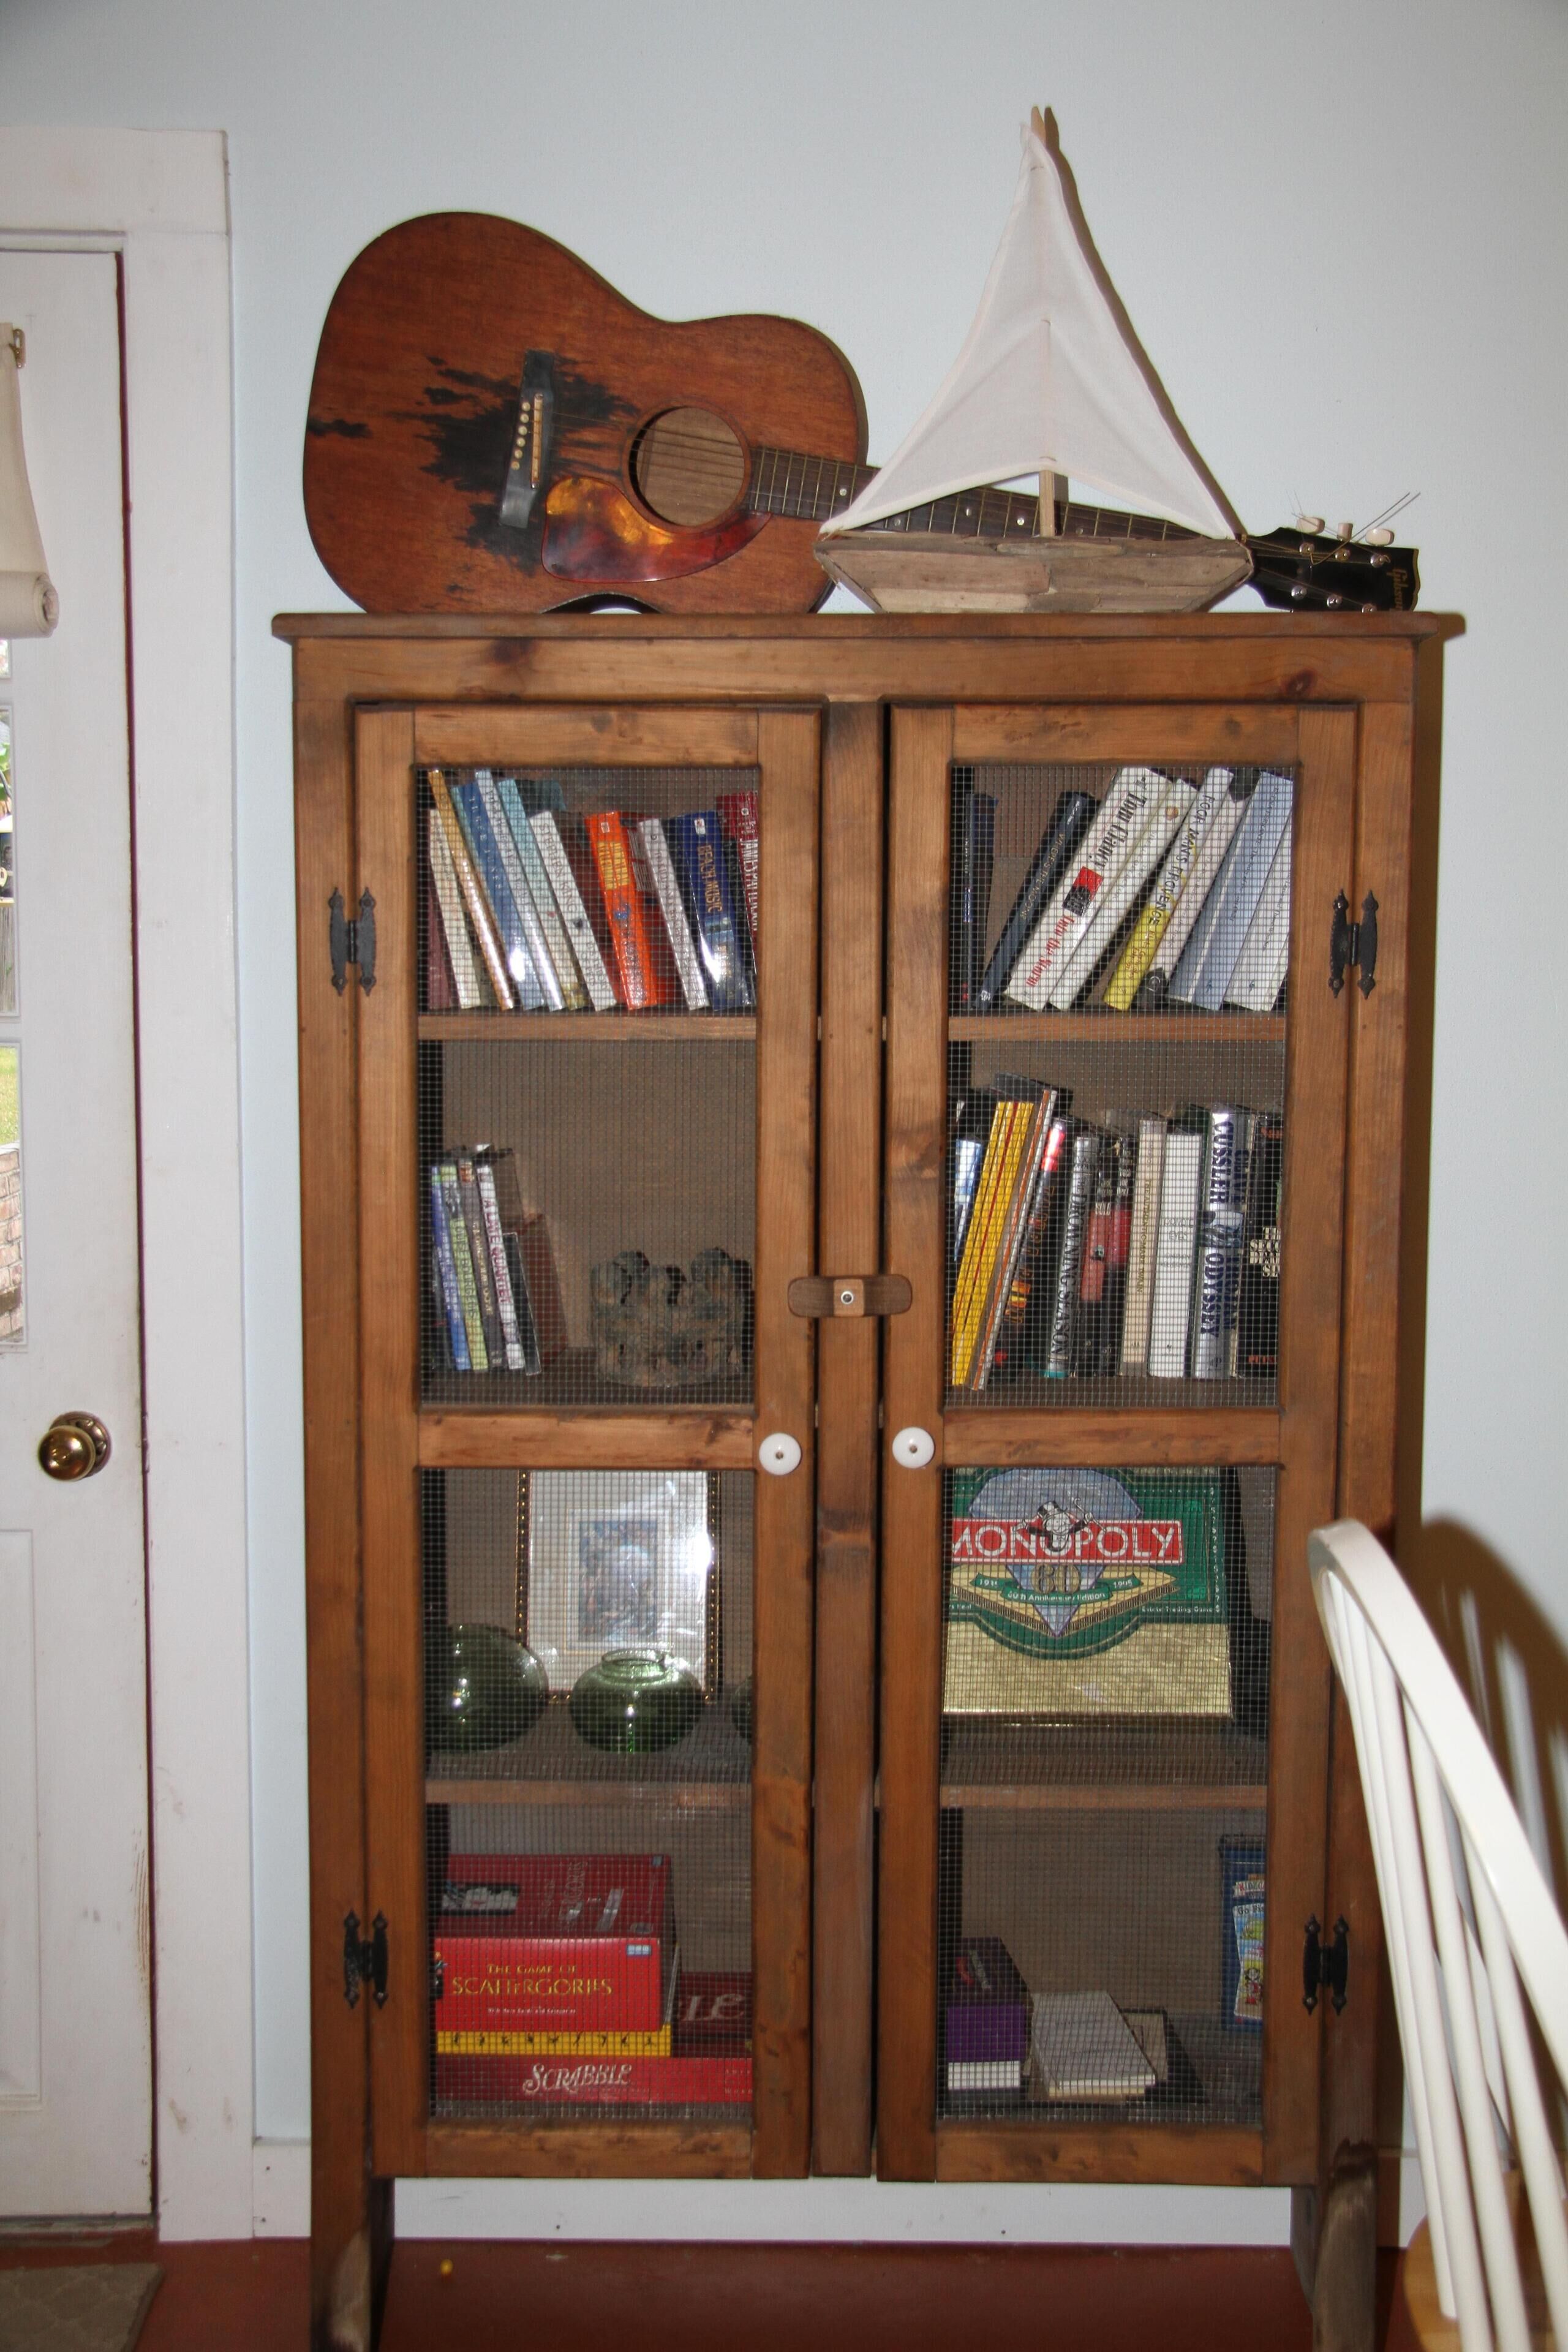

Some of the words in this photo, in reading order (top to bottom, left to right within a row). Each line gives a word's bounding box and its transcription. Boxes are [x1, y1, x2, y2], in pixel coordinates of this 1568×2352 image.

[1114, 789, 1148, 826] Tom
[1191, 793, 1215, 826] POOR
[740, 838, 758, 872] JAMES
[1090, 820, 1129, 869] Clancy
[697, 845, 715, 879] BEACH
[704, 880, 723, 913] MUSIC
[1145, 865, 1183, 927] PROVENCE
[1052, 913, 1076, 939] Into
[1042, 936, 1062, 957] the
[1024, 955, 1052, 989] Storm
[1210, 1121, 1234, 1203] CUSSLER
[484, 1211, 500, 1243] LATE
[1059, 1193, 1088, 1287] DROWNING
[1169, 1231, 1188, 1241] EYES
[1200, 1253, 1225, 1338] ODYSSEY
[1050, 1289, 1076, 1355] SEASON
[952, 1525, 1174, 1556] MONOPOLY
[1030, 1564, 1081, 1594] 60
[1028, 1594, 1074, 1602] Anniversary
[488, 1964, 511, 1973] THE
[516, 1964, 553, 1974] GAME
[453, 1977, 612, 1995] SCATTERGORIES
[522, 2063, 632, 2094] SCRABBLE
